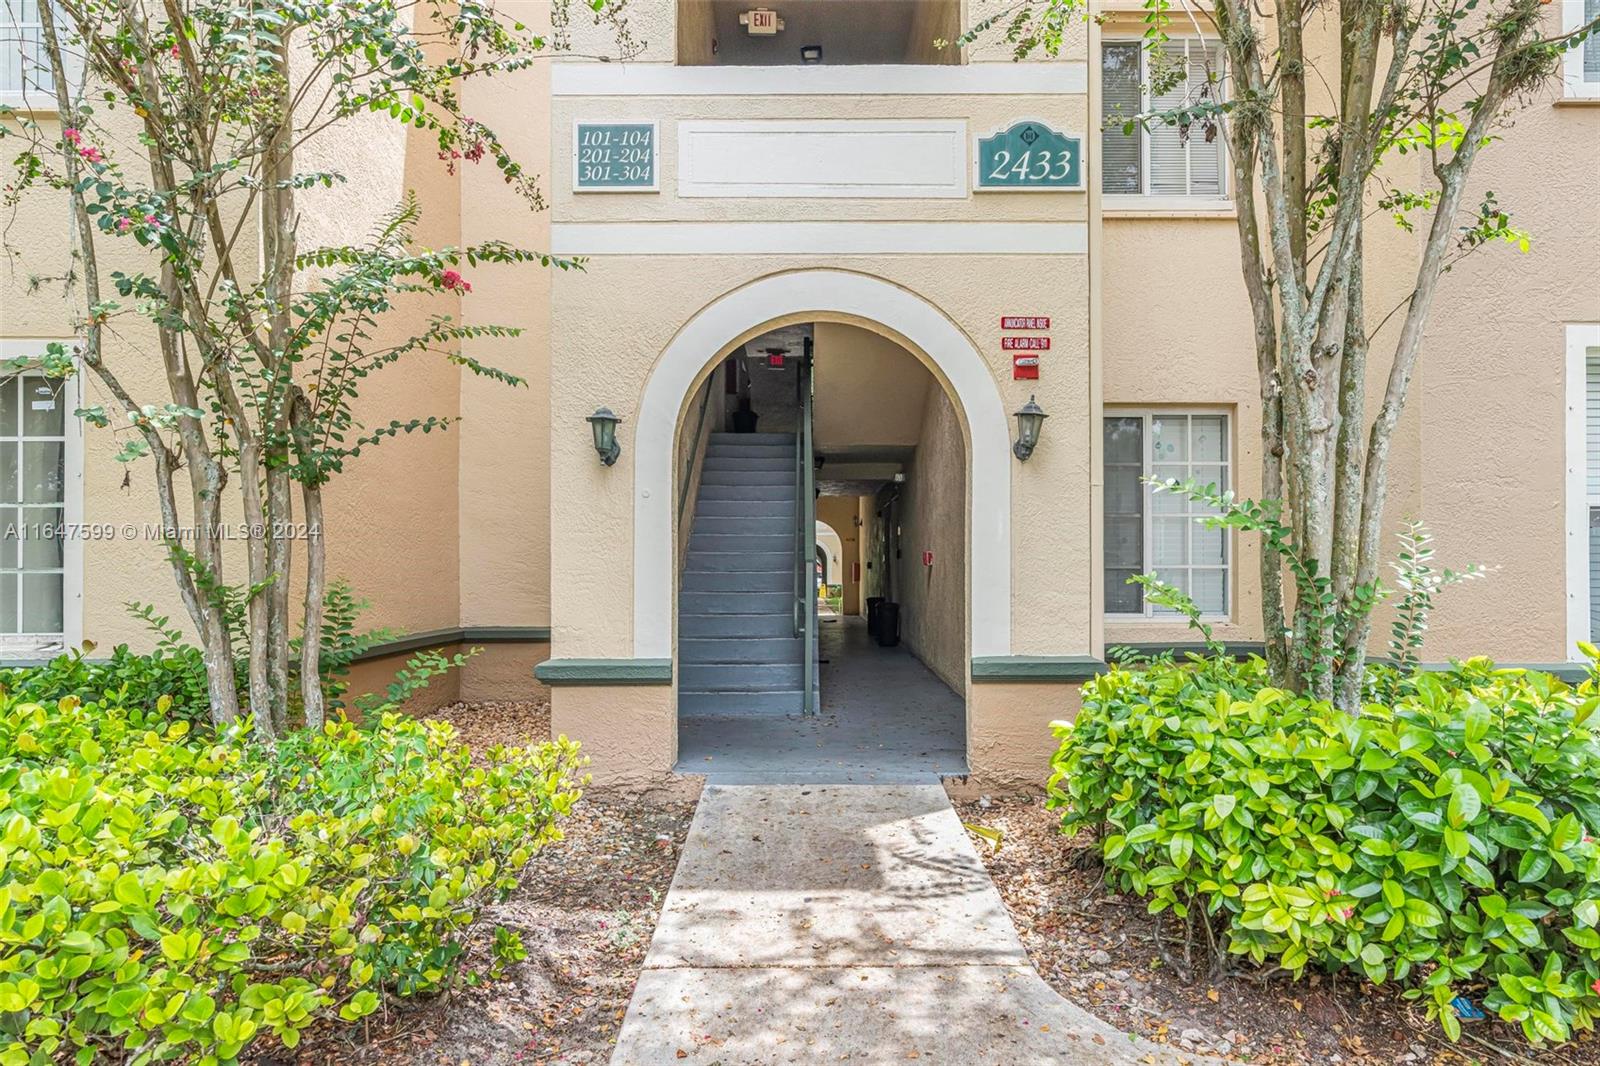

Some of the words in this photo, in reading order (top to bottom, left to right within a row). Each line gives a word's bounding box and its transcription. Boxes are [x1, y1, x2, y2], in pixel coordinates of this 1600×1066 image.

[753, 13, 771, 27] EXIT
[581, 131, 650, 146] 101-104
[580, 148, 650, 163] 201-204
[580, 165, 650, 180] 301-304
[988, 150, 1072, 180] 2433
[1004, 338, 1013, 348] FIRE
[1014, 338, 1028, 348] ALARM
[1029, 338, 1040, 348] CALL
